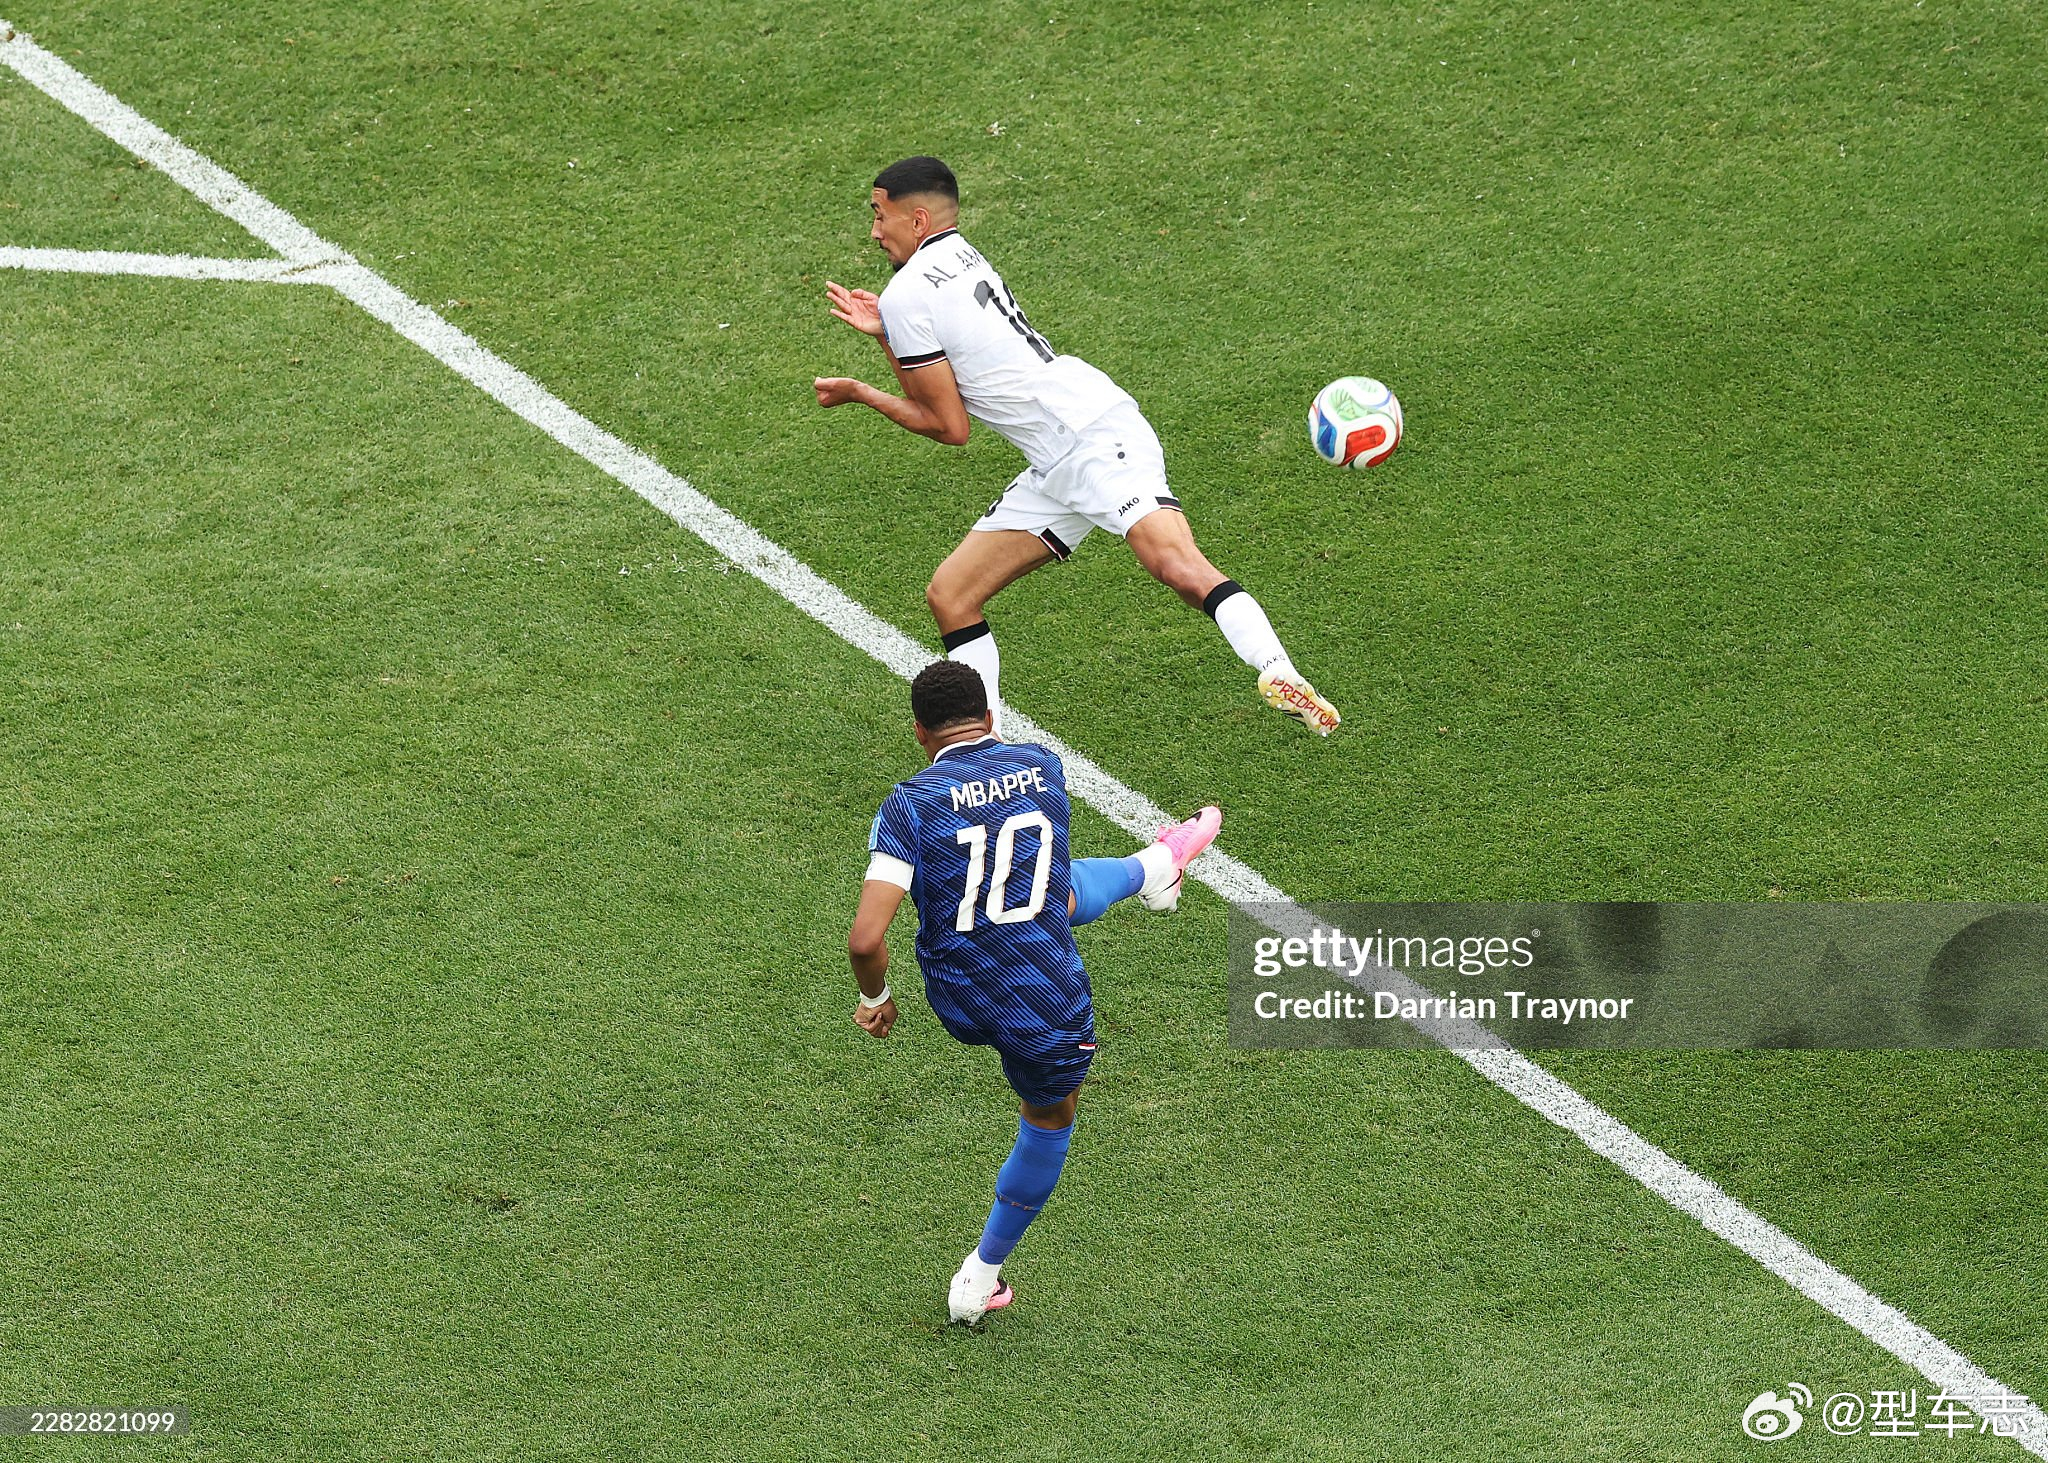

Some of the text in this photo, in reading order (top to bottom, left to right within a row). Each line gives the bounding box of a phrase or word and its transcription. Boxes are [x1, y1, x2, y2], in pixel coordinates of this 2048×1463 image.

[923, 265, 957, 288] AL
[1118, 497, 1140, 517] JAKO
[950, 767, 1047, 812] MBAPPE
[956, 811, 1053, 931] 10
